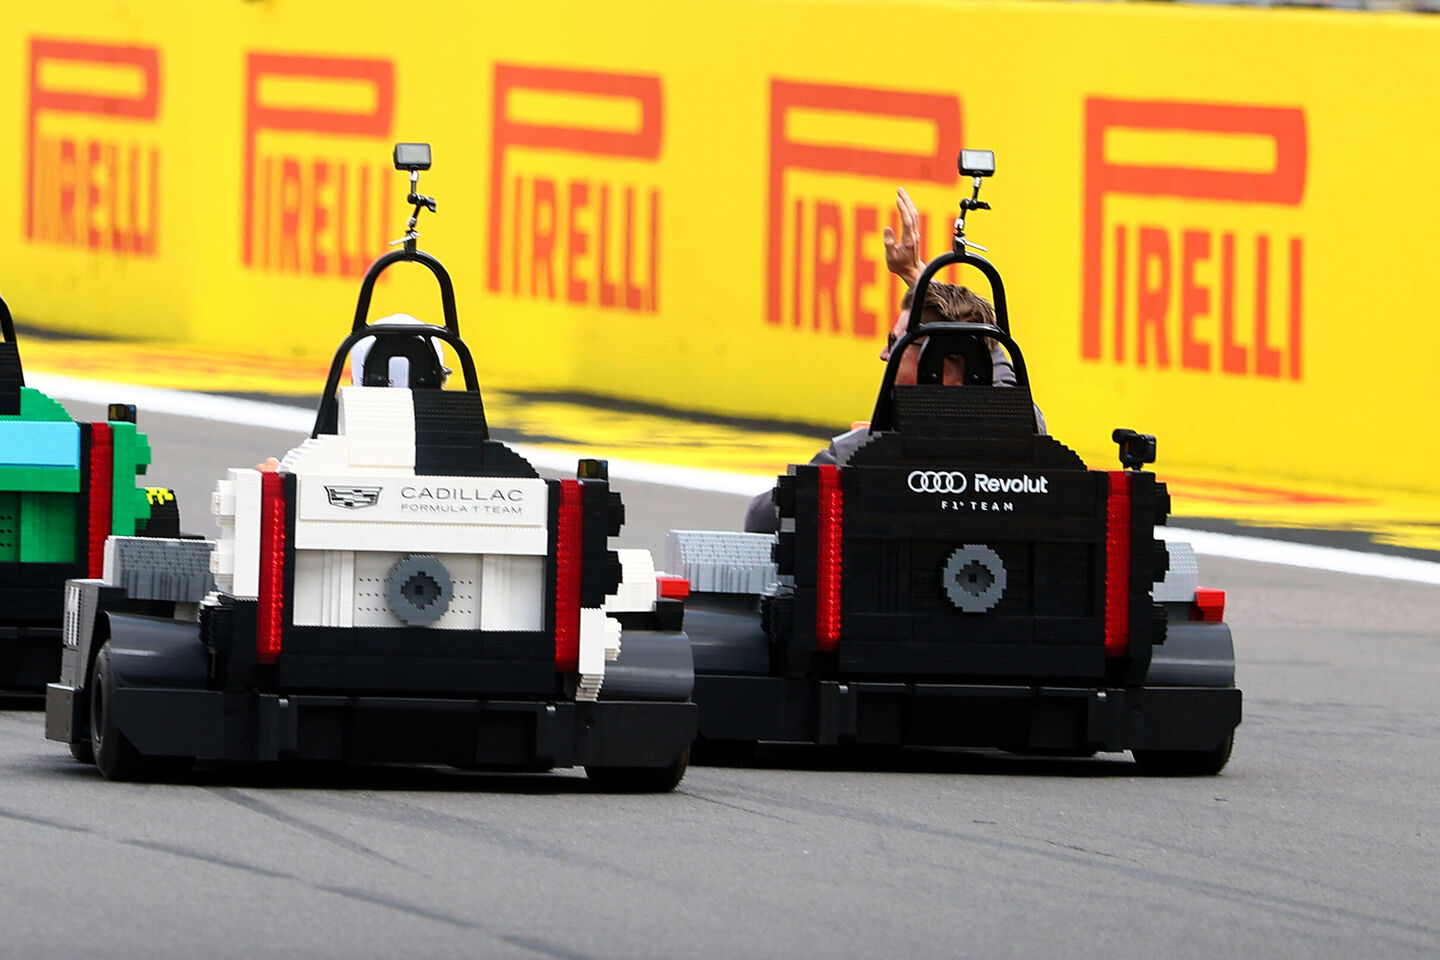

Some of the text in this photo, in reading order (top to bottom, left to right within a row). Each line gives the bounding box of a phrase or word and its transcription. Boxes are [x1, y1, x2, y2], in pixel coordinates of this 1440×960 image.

[242, 50, 395, 282] PIRELLI
[486, 62, 665, 315] PIRELLI
[1081, 95, 1309, 381] PIRELLI
[400, 486, 524, 502] CADILLAC
[974, 473, 1049, 494] Revolut
[400, 503, 469, 513] FORMULA
[483, 505, 523, 514] TEAM
[970, 501, 1015, 512] TEAM
